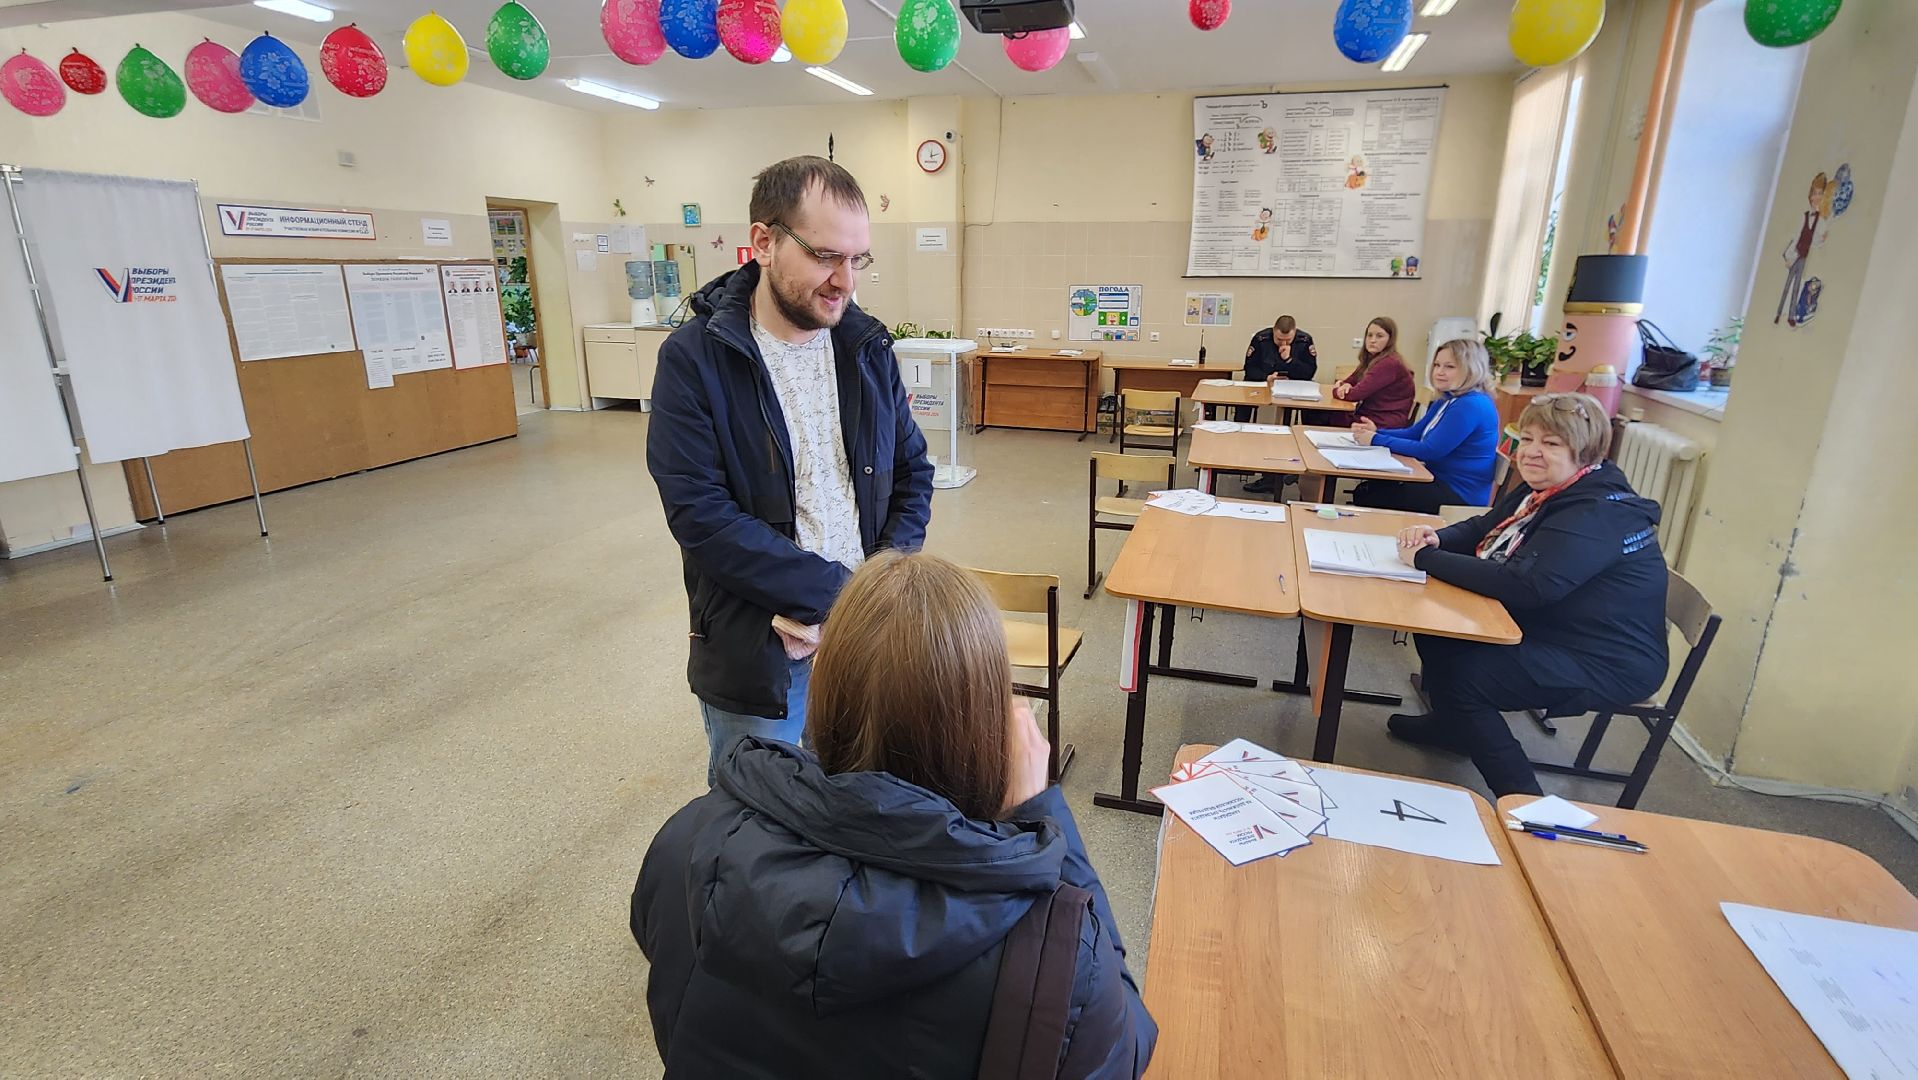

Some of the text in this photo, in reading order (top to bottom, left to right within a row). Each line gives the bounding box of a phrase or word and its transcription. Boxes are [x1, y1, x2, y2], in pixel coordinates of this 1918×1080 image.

[279, 215, 368, 227] ИНФОРМАЦИОННЫЙ СТЕНД
[131, 267, 170, 275] ВЫБОРЫ
[914, 364, 921, 384] 1
[1379, 798, 1447, 825] 4
